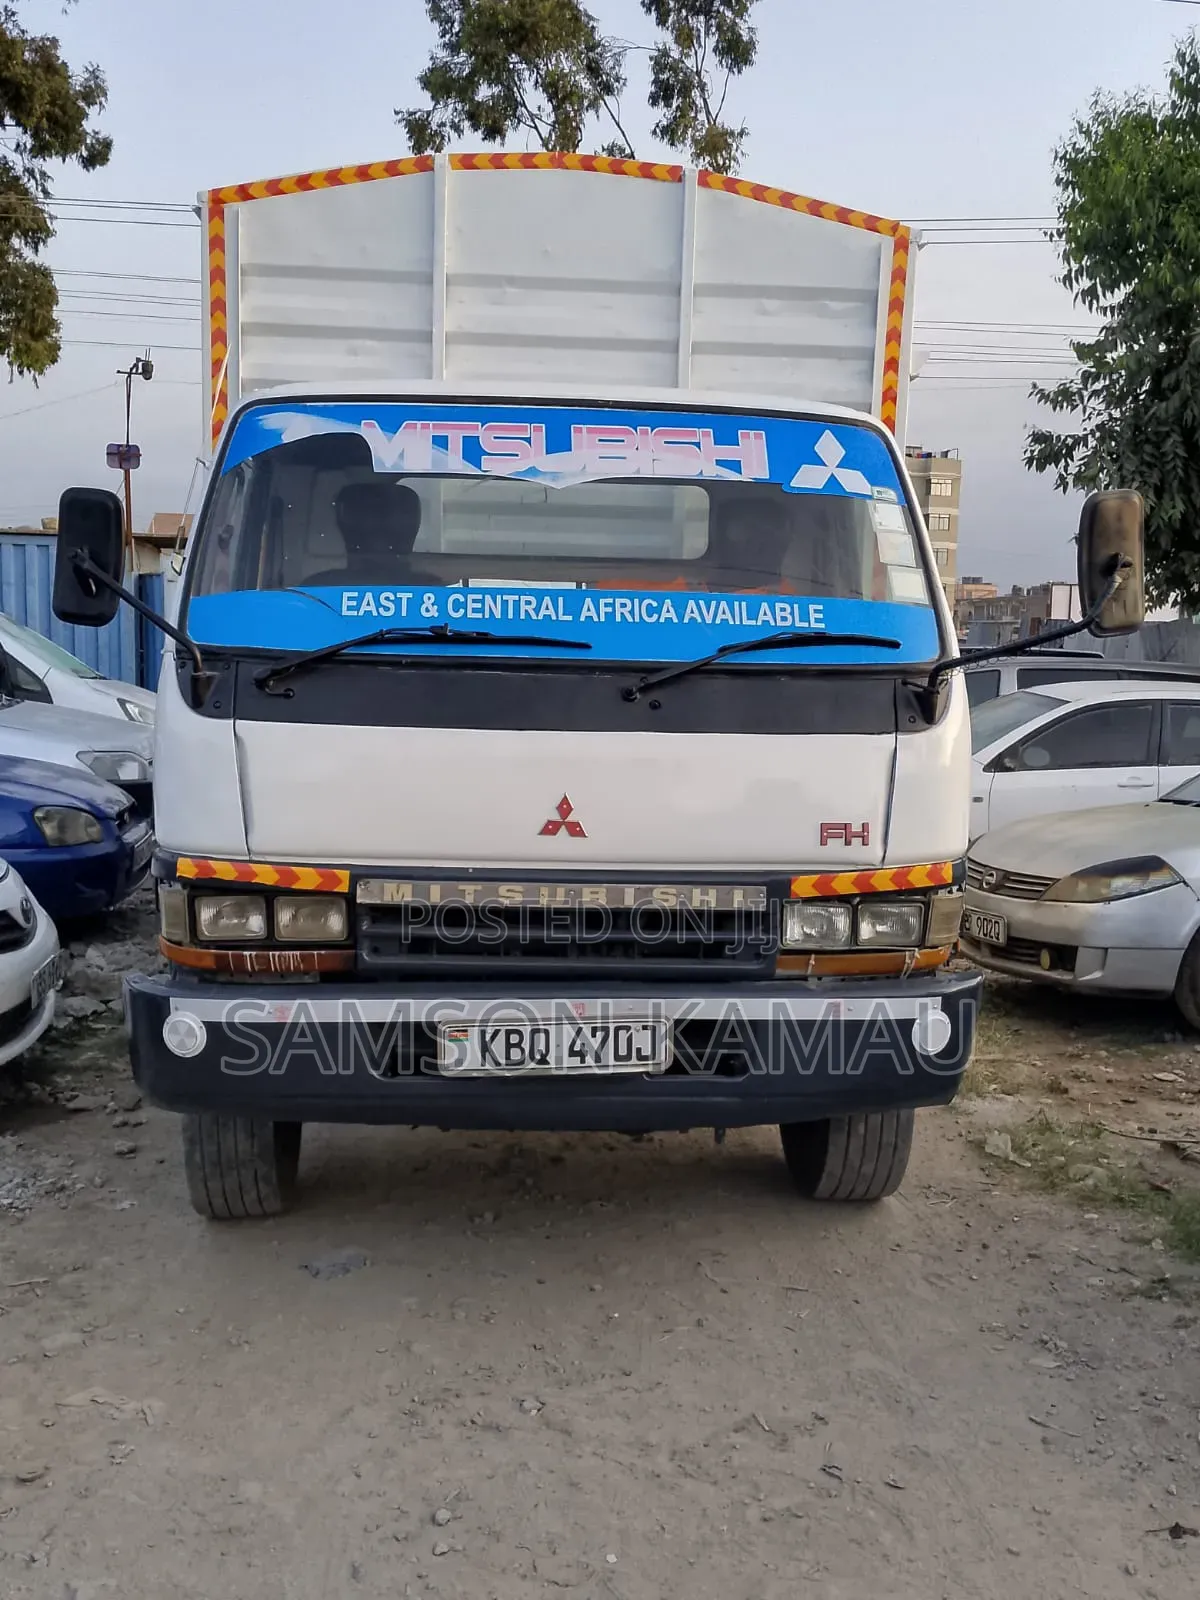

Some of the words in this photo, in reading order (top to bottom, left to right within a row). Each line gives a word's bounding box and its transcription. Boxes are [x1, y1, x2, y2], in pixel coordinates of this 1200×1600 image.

[361, 420, 769, 479] MITSUBISHI
[340, 591, 413, 617] EAST
[420, 592, 439, 618] &
[446, 592, 571, 622] CENTRAL
[579, 598, 675, 624] AFRICA
[682, 600, 826, 629] AVAILABLE
[820, 822, 869, 846] FH
[382, 882, 745, 908] MITSUBISHI
[976, 915, 1001, 942] 902Q
[480, 1027, 551, 1067] KBQ
[568, 1024, 657, 1064] 470J
